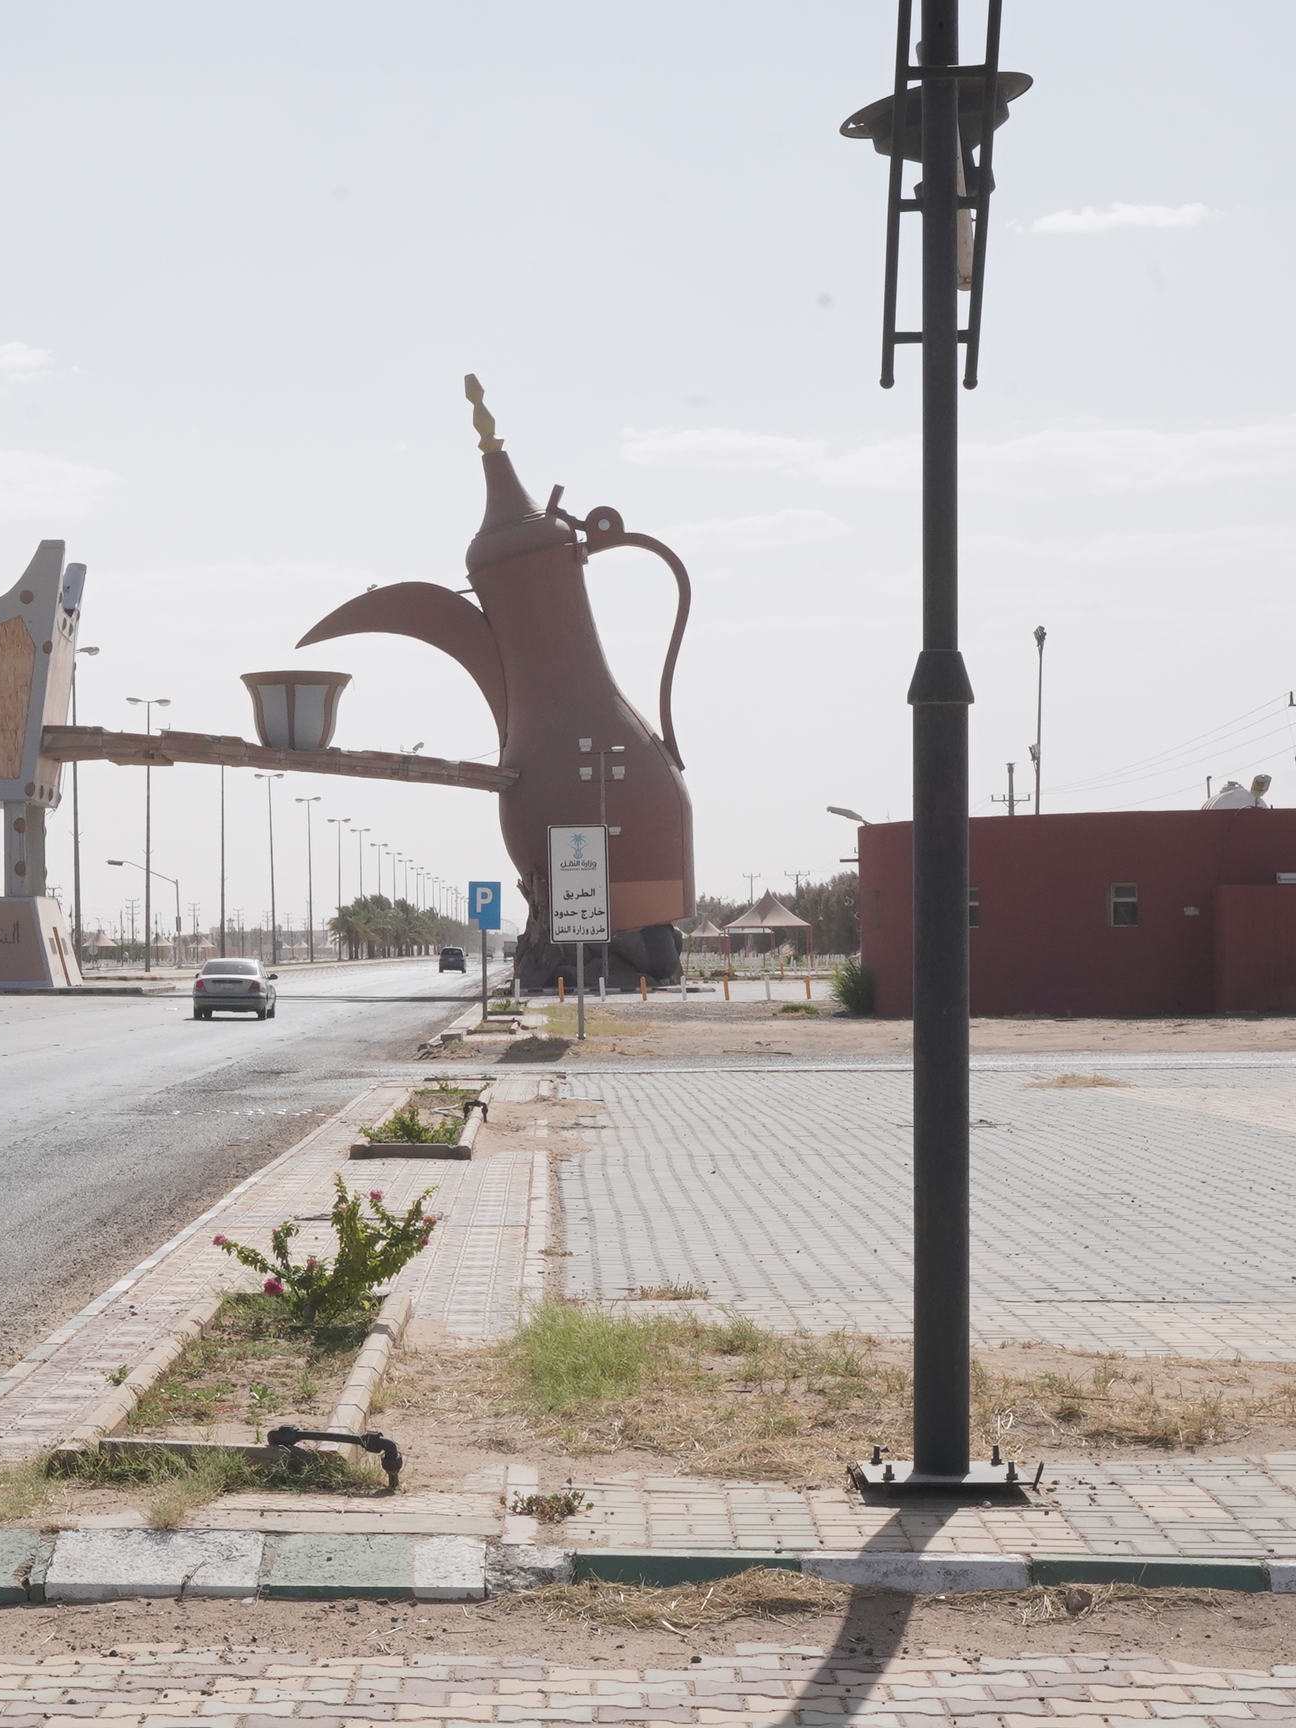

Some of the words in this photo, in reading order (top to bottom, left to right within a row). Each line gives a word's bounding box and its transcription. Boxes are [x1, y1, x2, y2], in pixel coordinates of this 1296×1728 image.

[560, 860, 580, 868] النقل
[581, 860, 597, 868] وزارة
[563, 888, 596, 900] الطريق
[476, 887, 493, 913] P
[554, 908, 578, 919] حدود
[581, 907, 605, 919] خارج
[555, 924, 571, 936] النقل
[572, 924, 589, 935] وزارة
[590, 924, 605, 935] طرق
